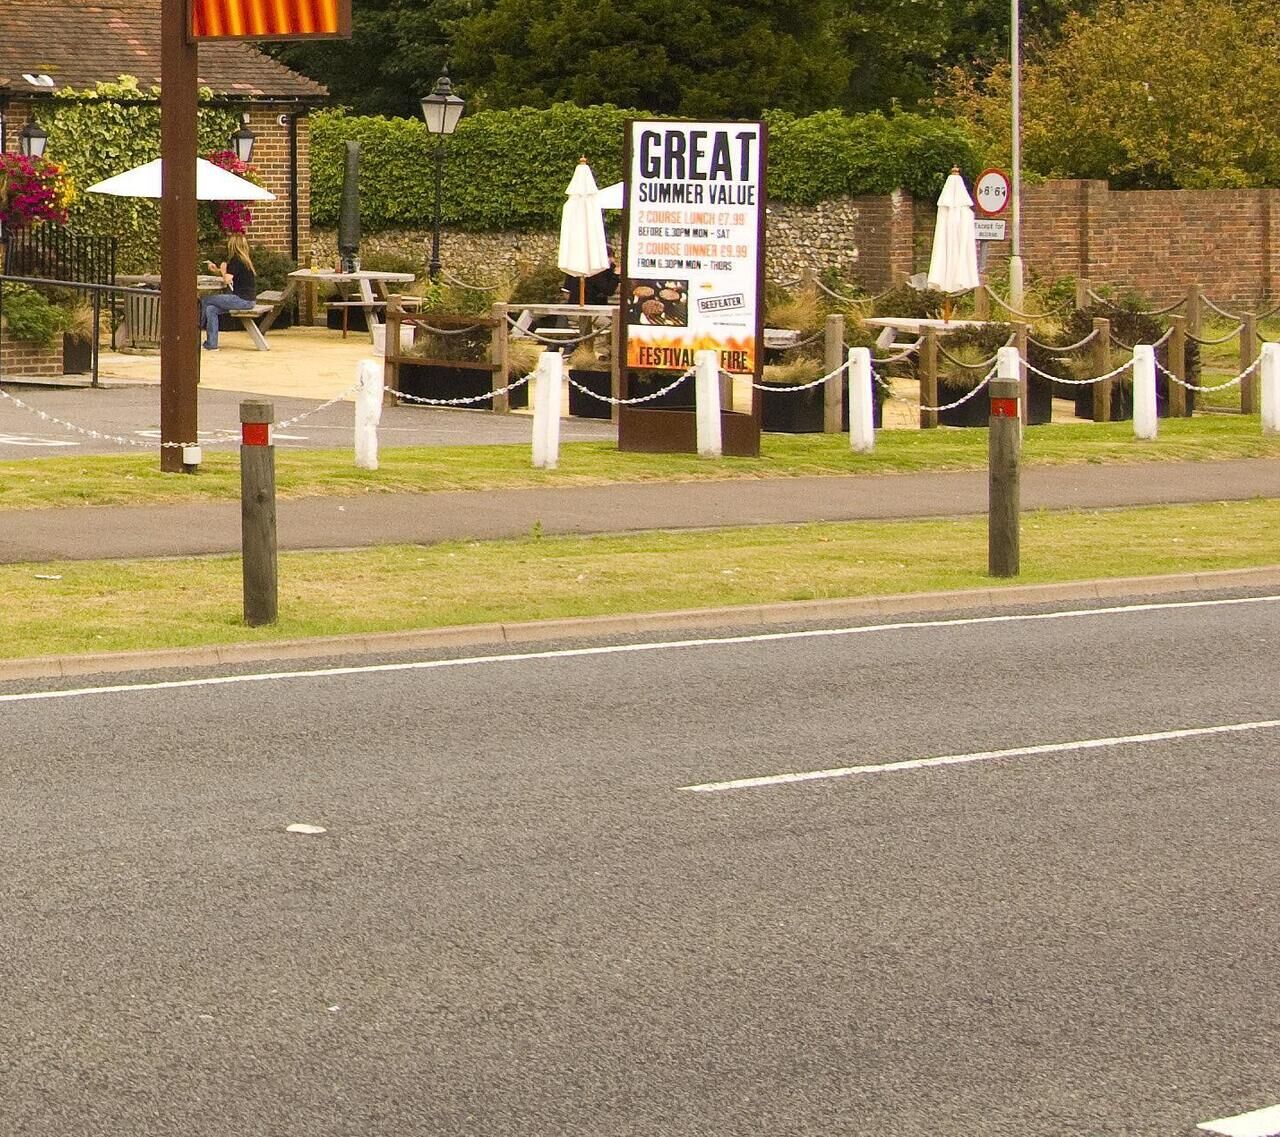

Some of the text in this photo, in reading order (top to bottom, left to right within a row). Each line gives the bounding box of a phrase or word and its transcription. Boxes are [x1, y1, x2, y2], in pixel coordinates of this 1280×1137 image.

[639, 129, 757, 182] GREAT
[639, 182, 755, 206] SUMMER VALUE
[638, 210, 645, 224] 2
[646, 210, 681, 225] COURSE
[684, 211, 715, 226] LUNCH
[638, 226, 663, 238] BEFORE
[692, 228, 708, 238] MON
[717, 229, 730, 239] SAT
[638, 242, 645, 255] 2
[646, 242, 681, 256] COURSE
[684, 243, 717, 258] DINNER
[637, 258, 656, 269] FROM
[686, 259, 701, 270] MON
[700, 296, 742, 310] BEEFEATER
[639, 347, 748, 370] FESTIVAL FIRE
